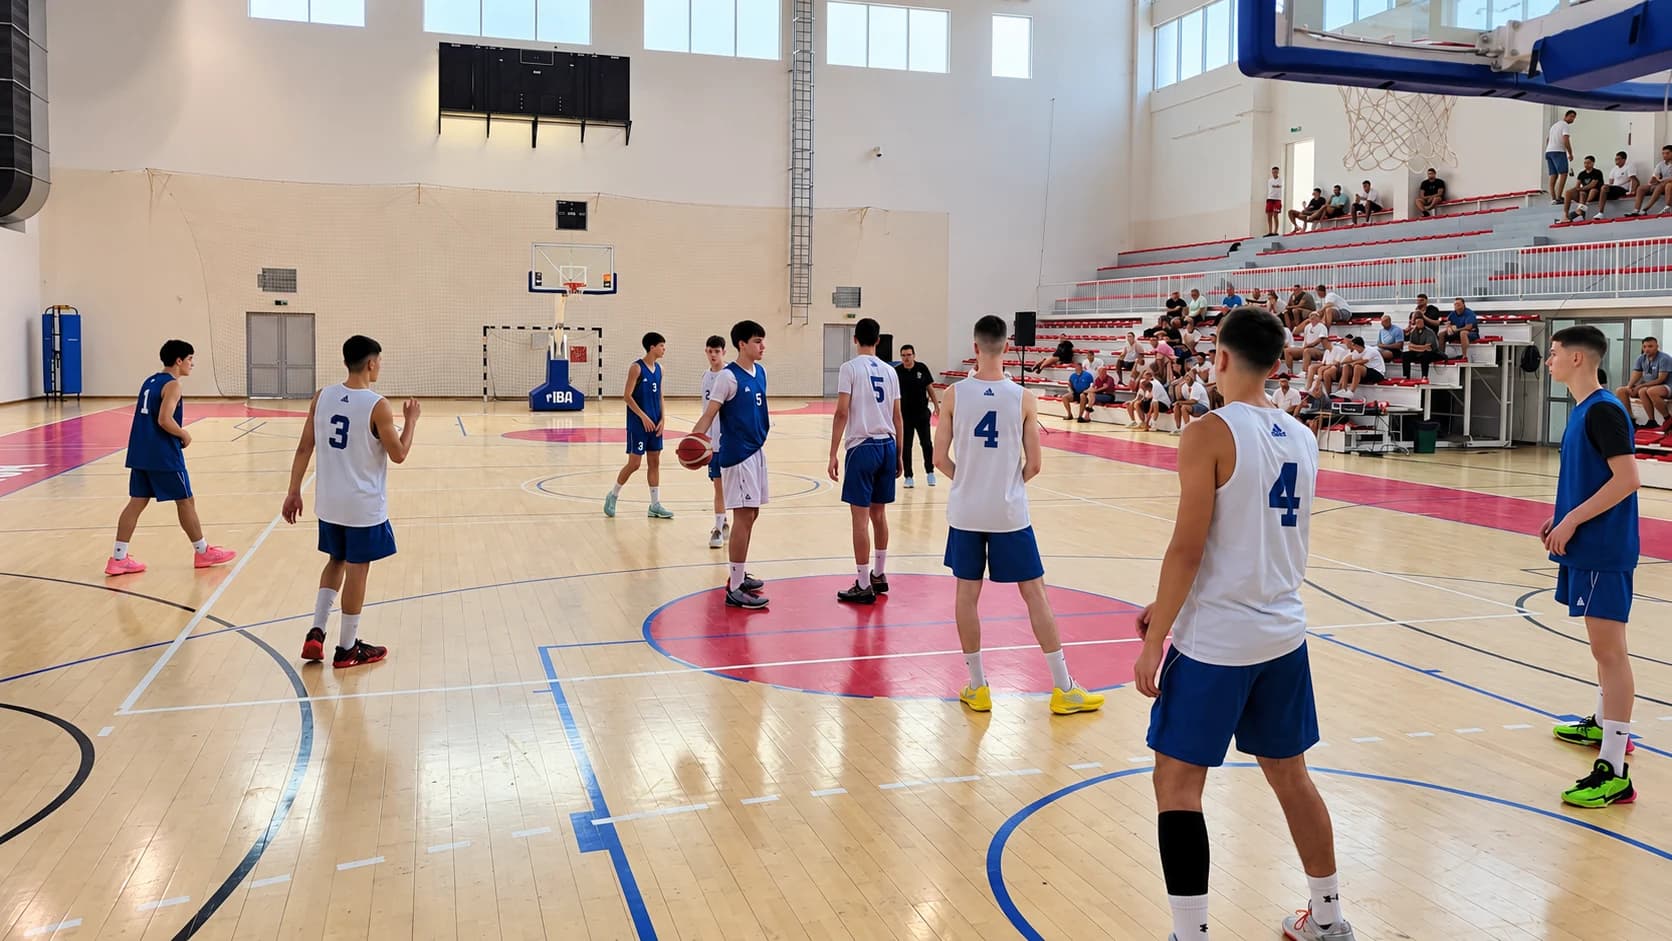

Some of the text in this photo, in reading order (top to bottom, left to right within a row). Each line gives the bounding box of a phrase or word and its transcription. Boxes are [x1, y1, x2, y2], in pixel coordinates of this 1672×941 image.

[652, 382, 657, 392] 3
[756, 393, 762, 406] 5
[870, 376, 884, 403] 5
[141, 389, 150, 414] 1
[329, 414, 350, 449] 3
[974, 410, 998, 448] 4
[638, 441, 644, 451] 3
[1269, 462, 1300, 527] 4
